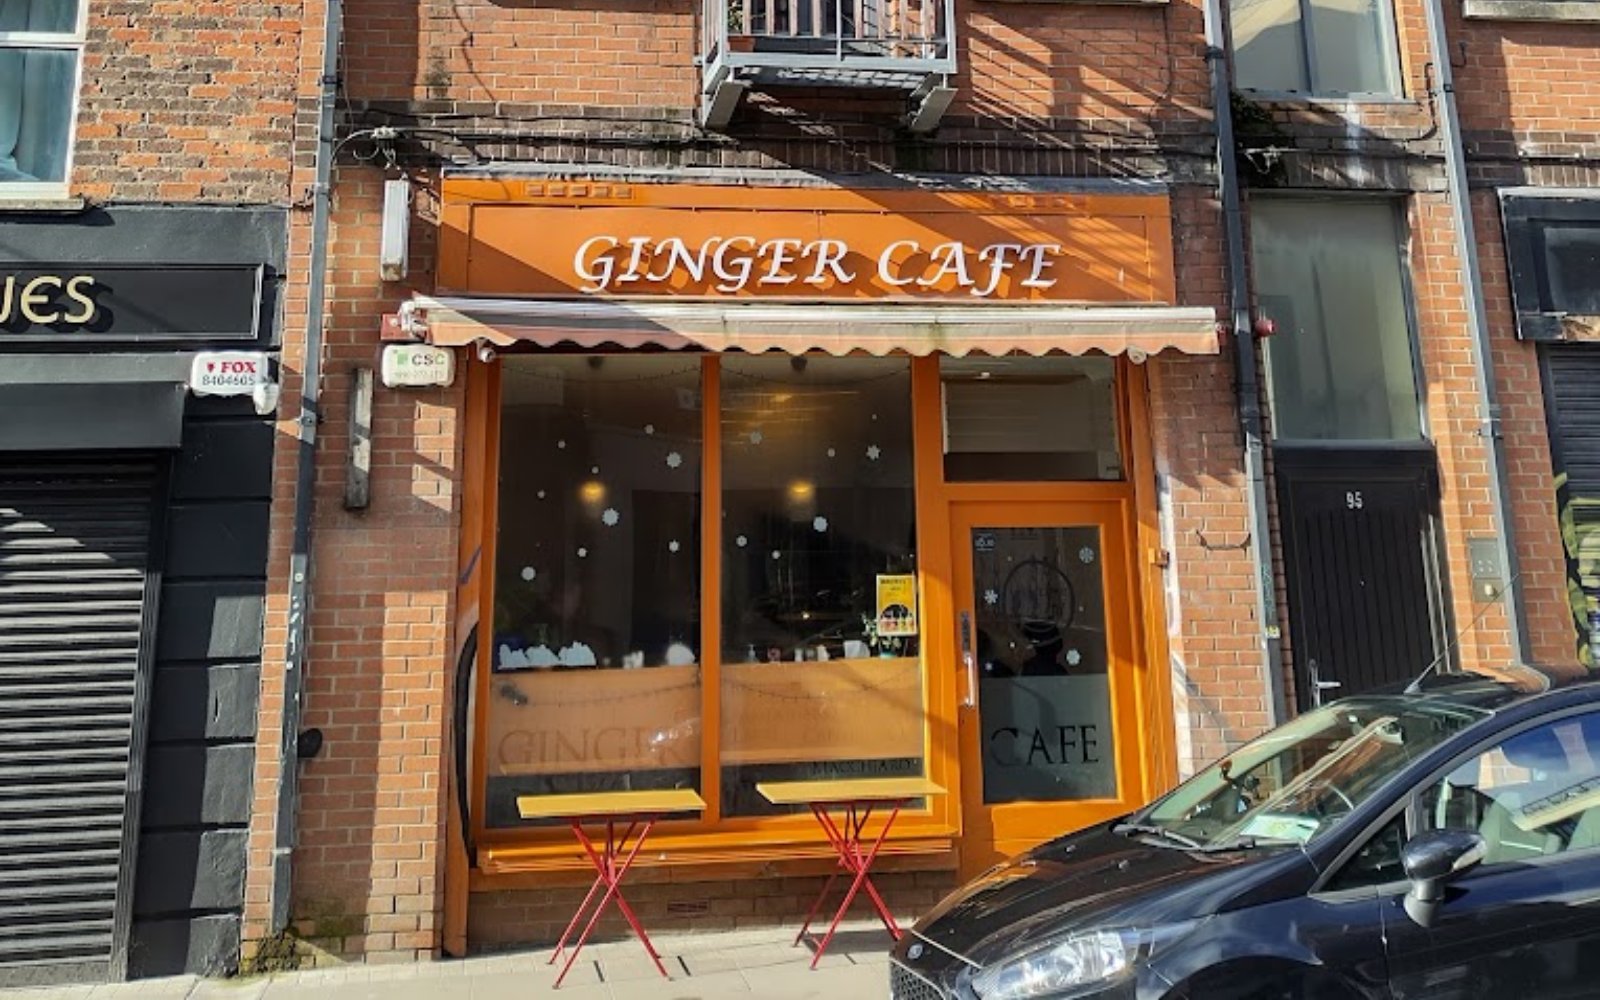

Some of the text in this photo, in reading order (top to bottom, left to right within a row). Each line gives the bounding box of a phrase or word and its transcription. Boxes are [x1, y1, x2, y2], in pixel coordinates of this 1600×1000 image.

[572, 235, 1062, 296] GINGER CAFE
[221, 361, 256, 373] FOX
[412, 353, 445, 366] CSC
[1346, 491, 1362, 509] 95
[990, 724, 1100, 767] CAFE
